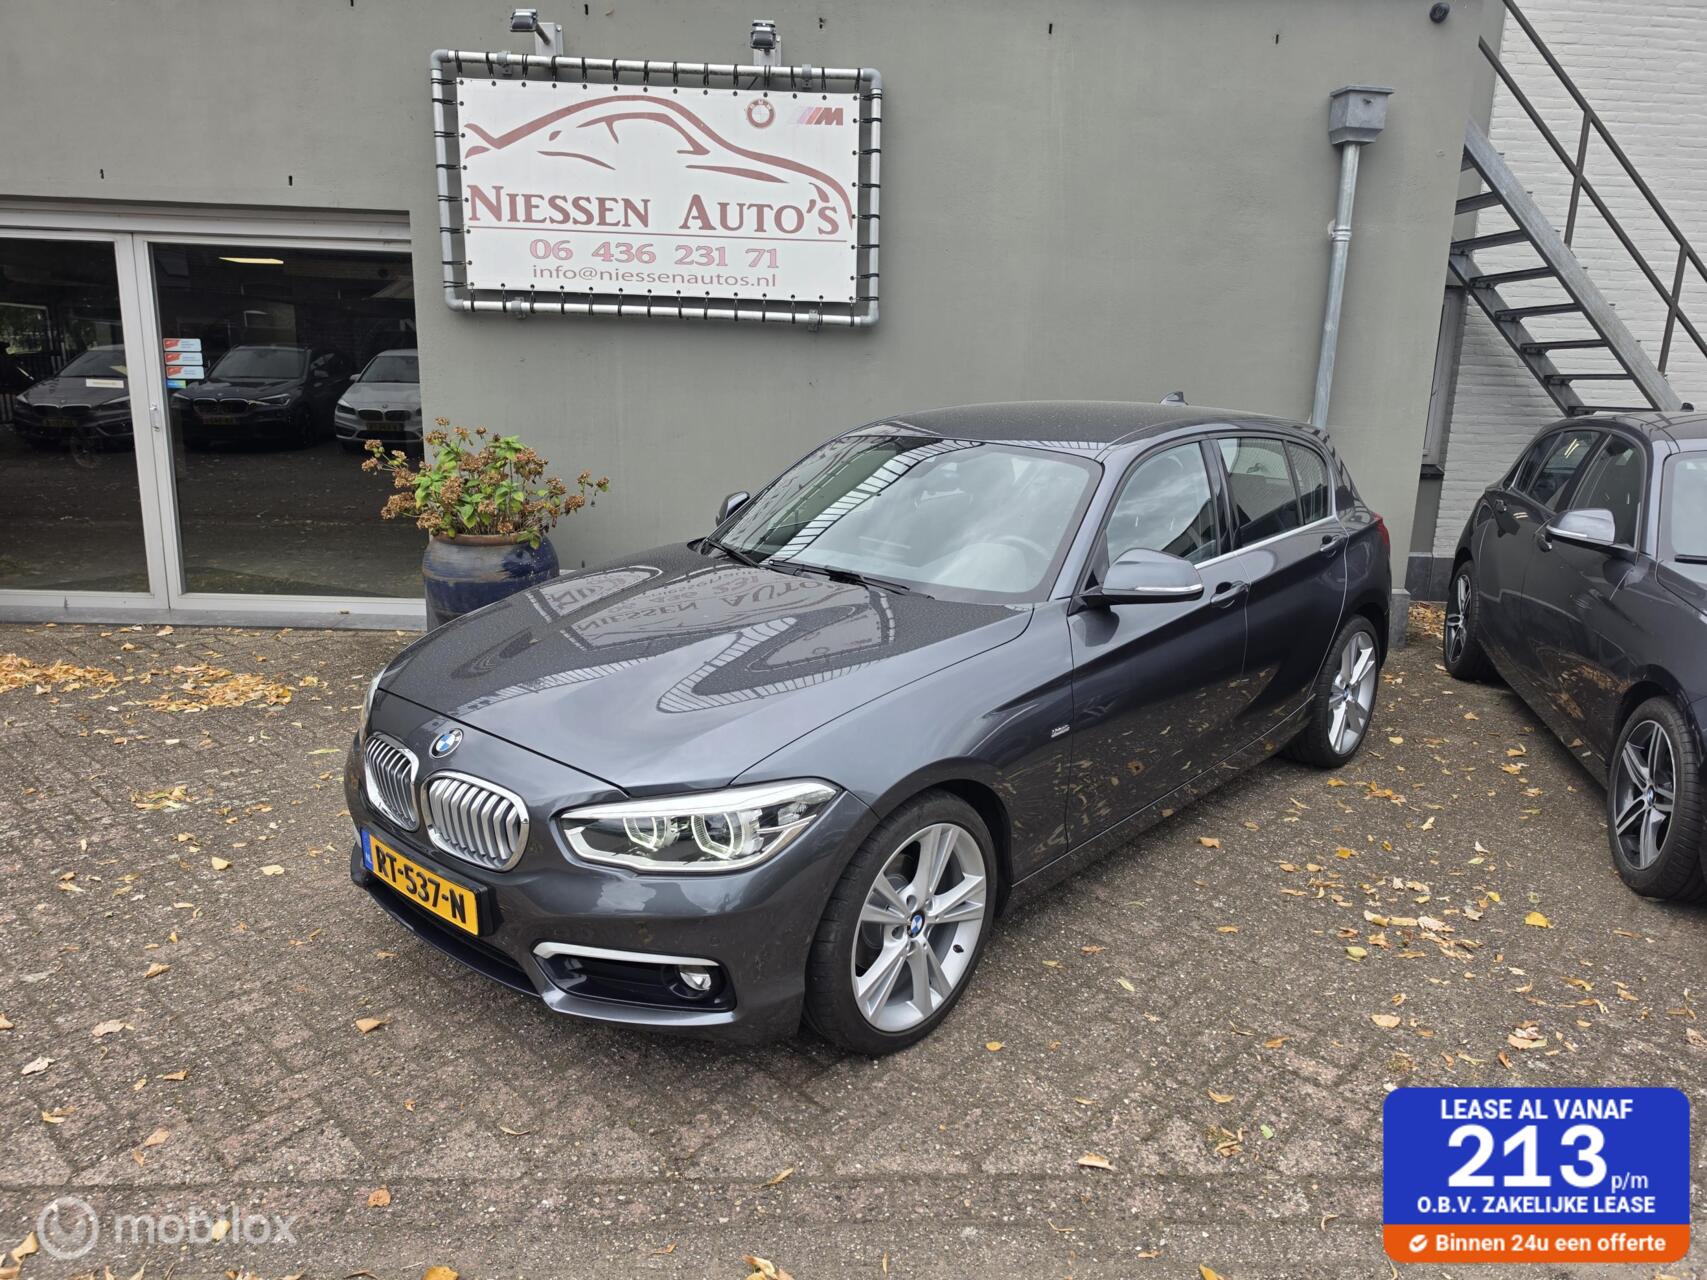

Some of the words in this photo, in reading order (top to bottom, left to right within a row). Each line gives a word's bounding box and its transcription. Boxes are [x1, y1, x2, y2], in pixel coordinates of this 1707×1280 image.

[467, 184, 651, 228] NIESSEN
[678, 194, 839, 235] AUTO'S
[529, 238, 574, 261] 06
[591, 241, 657, 264] 436
[674, 244, 728, 267] 231
[745, 248, 779, 268] 71
[533, 264, 777, 288] info@niessenautos.nl
[375, 845, 467, 925] RT-537-N
